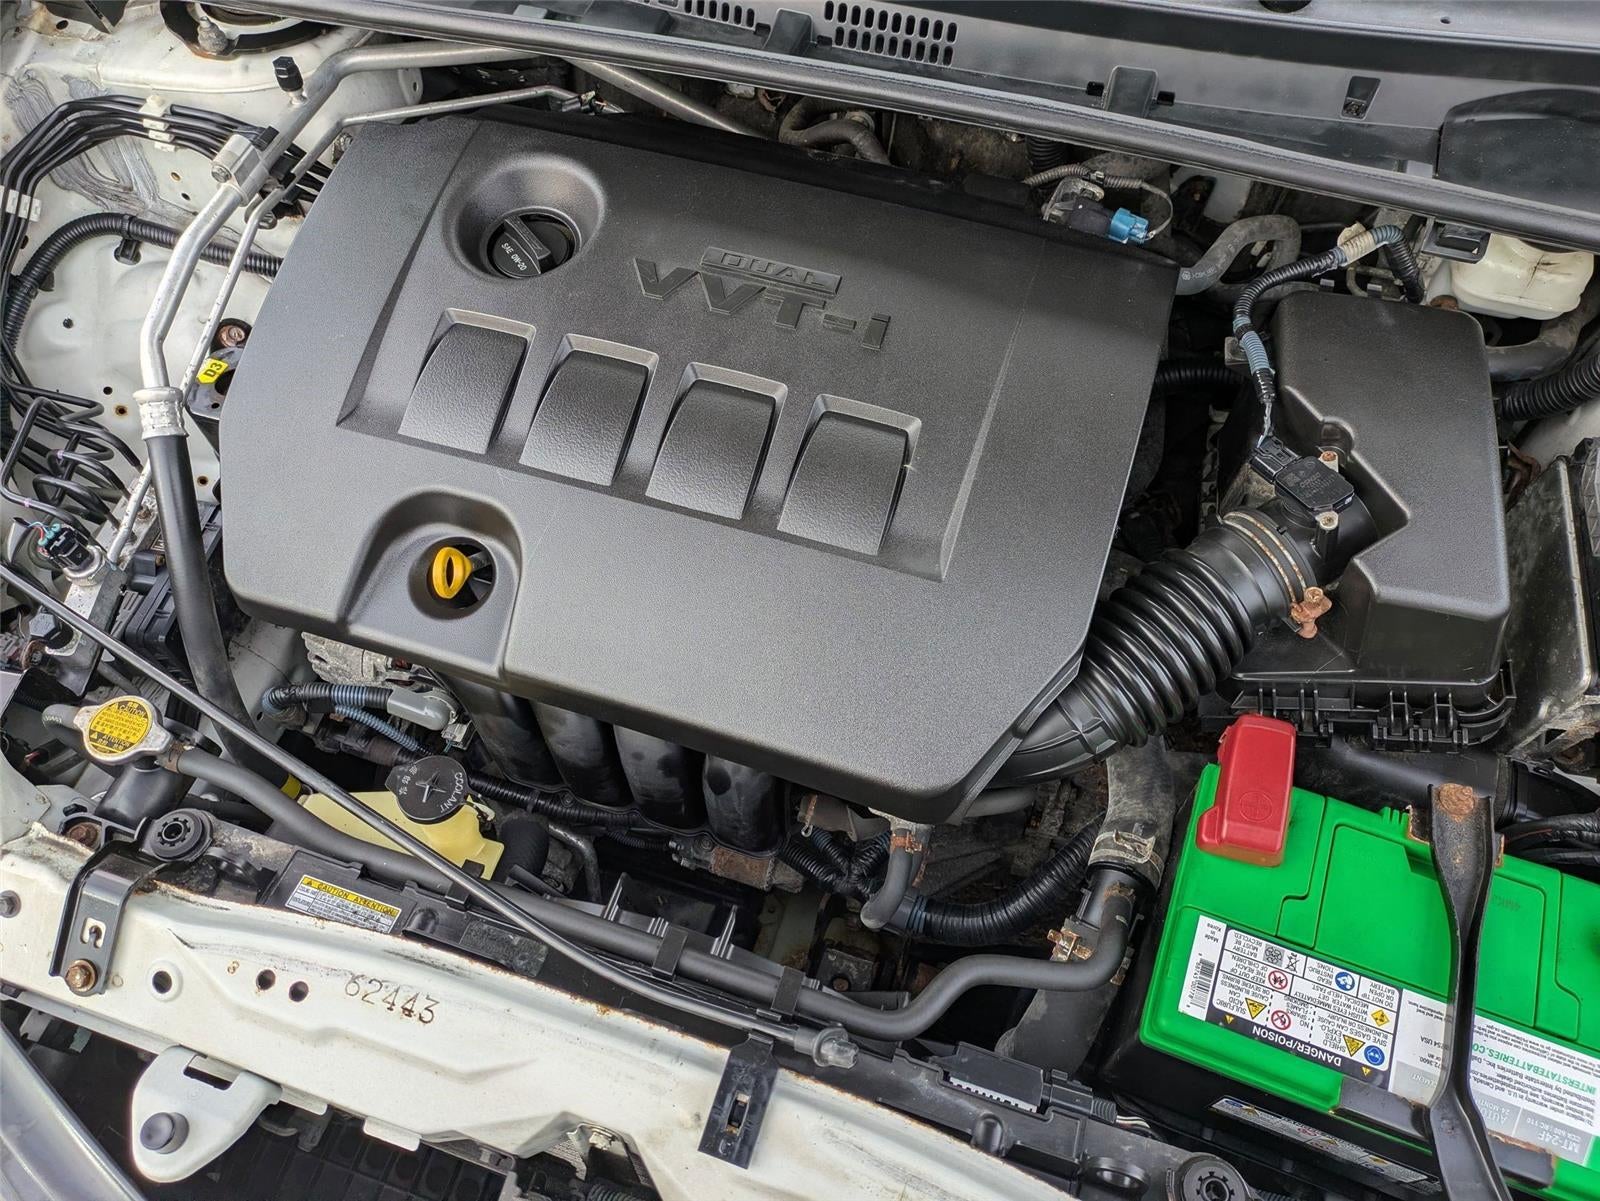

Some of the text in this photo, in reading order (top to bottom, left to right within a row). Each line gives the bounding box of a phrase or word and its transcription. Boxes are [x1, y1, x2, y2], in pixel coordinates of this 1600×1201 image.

[501, 242, 527, 270] SAE 0W-20
[721, 253, 826, 287] DUAL
[203, 362, 222, 377] D3
[439, 771, 463, 812] COOLANT
[317, 882, 349, 899] CAUTION
[1206, 922, 1221, 931] Korea
[1203, 933, 1219, 943] Made
[1234, 938, 1258, 951] MUST BE
[1232, 944, 1257, 958] BATTERY
[1234, 962, 1266, 978] THE REACH
[1238, 969, 1250, 978] OUT
[1250, 974, 1265, 984] KEEP
[1316, 975, 1332, 985] READ
[1219, 979, 1269, 1001] CAUSE BLINDNESS
[1240, 980, 1261, 992] SEVERE
[1368, 987, 1385, 998] OPEN
[345, 974, 440, 1023] 62443
[1228, 989, 1240, 997] CAN
[1317, 992, 1329, 1001] GET
[1326, 989, 1342, 999] HELP
[1360, 991, 1370, 999] TIP
[1371, 995, 1384, 1004] NOT
[1215, 998, 1246, 1014] SULFURIC
[1227, 996, 1243, 1006] ACID
[1293, 990, 1367, 1022] FLUSH EYES IMMEDIATELY
[1342, 995, 1369, 1009] MEDICAL
[1352, 1005, 1367, 1015] WITH
[1298, 1019, 1309, 1028] NO
[1316, 1015, 1387, 1046] SIVE GASES CAN CAUSE
[1356, 1023, 1388, 1039] BLINDNESS
[1251, 1025, 1342, 1066] DANGER/POISON
[1321, 1038, 1346, 1052] SHIELD
[1419, 1035, 1433, 1045] USA
[1470, 1042, 1596, 1095] INTERSTATEBATTERIES.CO
[1536, 1129, 1580, 1153] MT-24F
[1566, 1131, 1581, 1142] CCA
